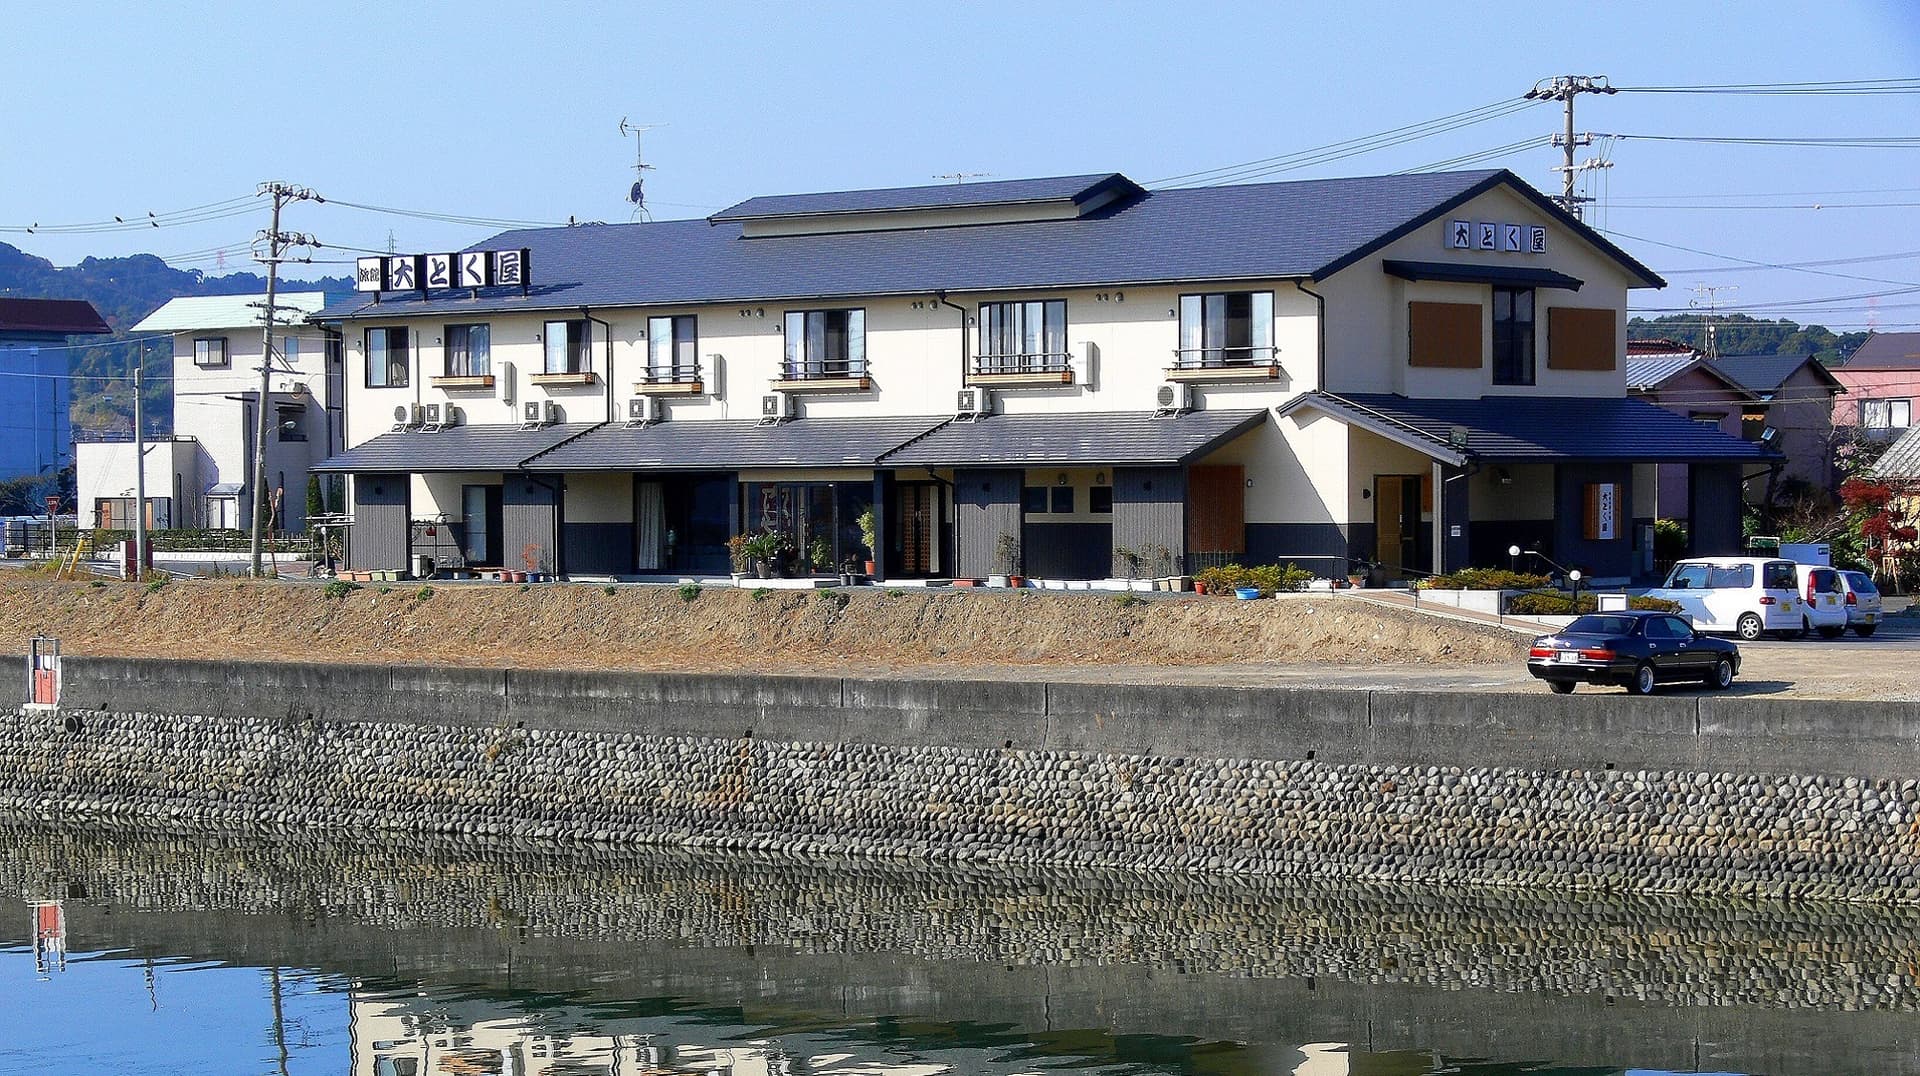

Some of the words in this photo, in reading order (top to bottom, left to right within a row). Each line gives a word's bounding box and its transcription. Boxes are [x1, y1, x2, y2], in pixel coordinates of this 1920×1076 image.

[1456, 224, 1543, 250] 大とく屋
[394, 252, 519, 287] 大とく屋
